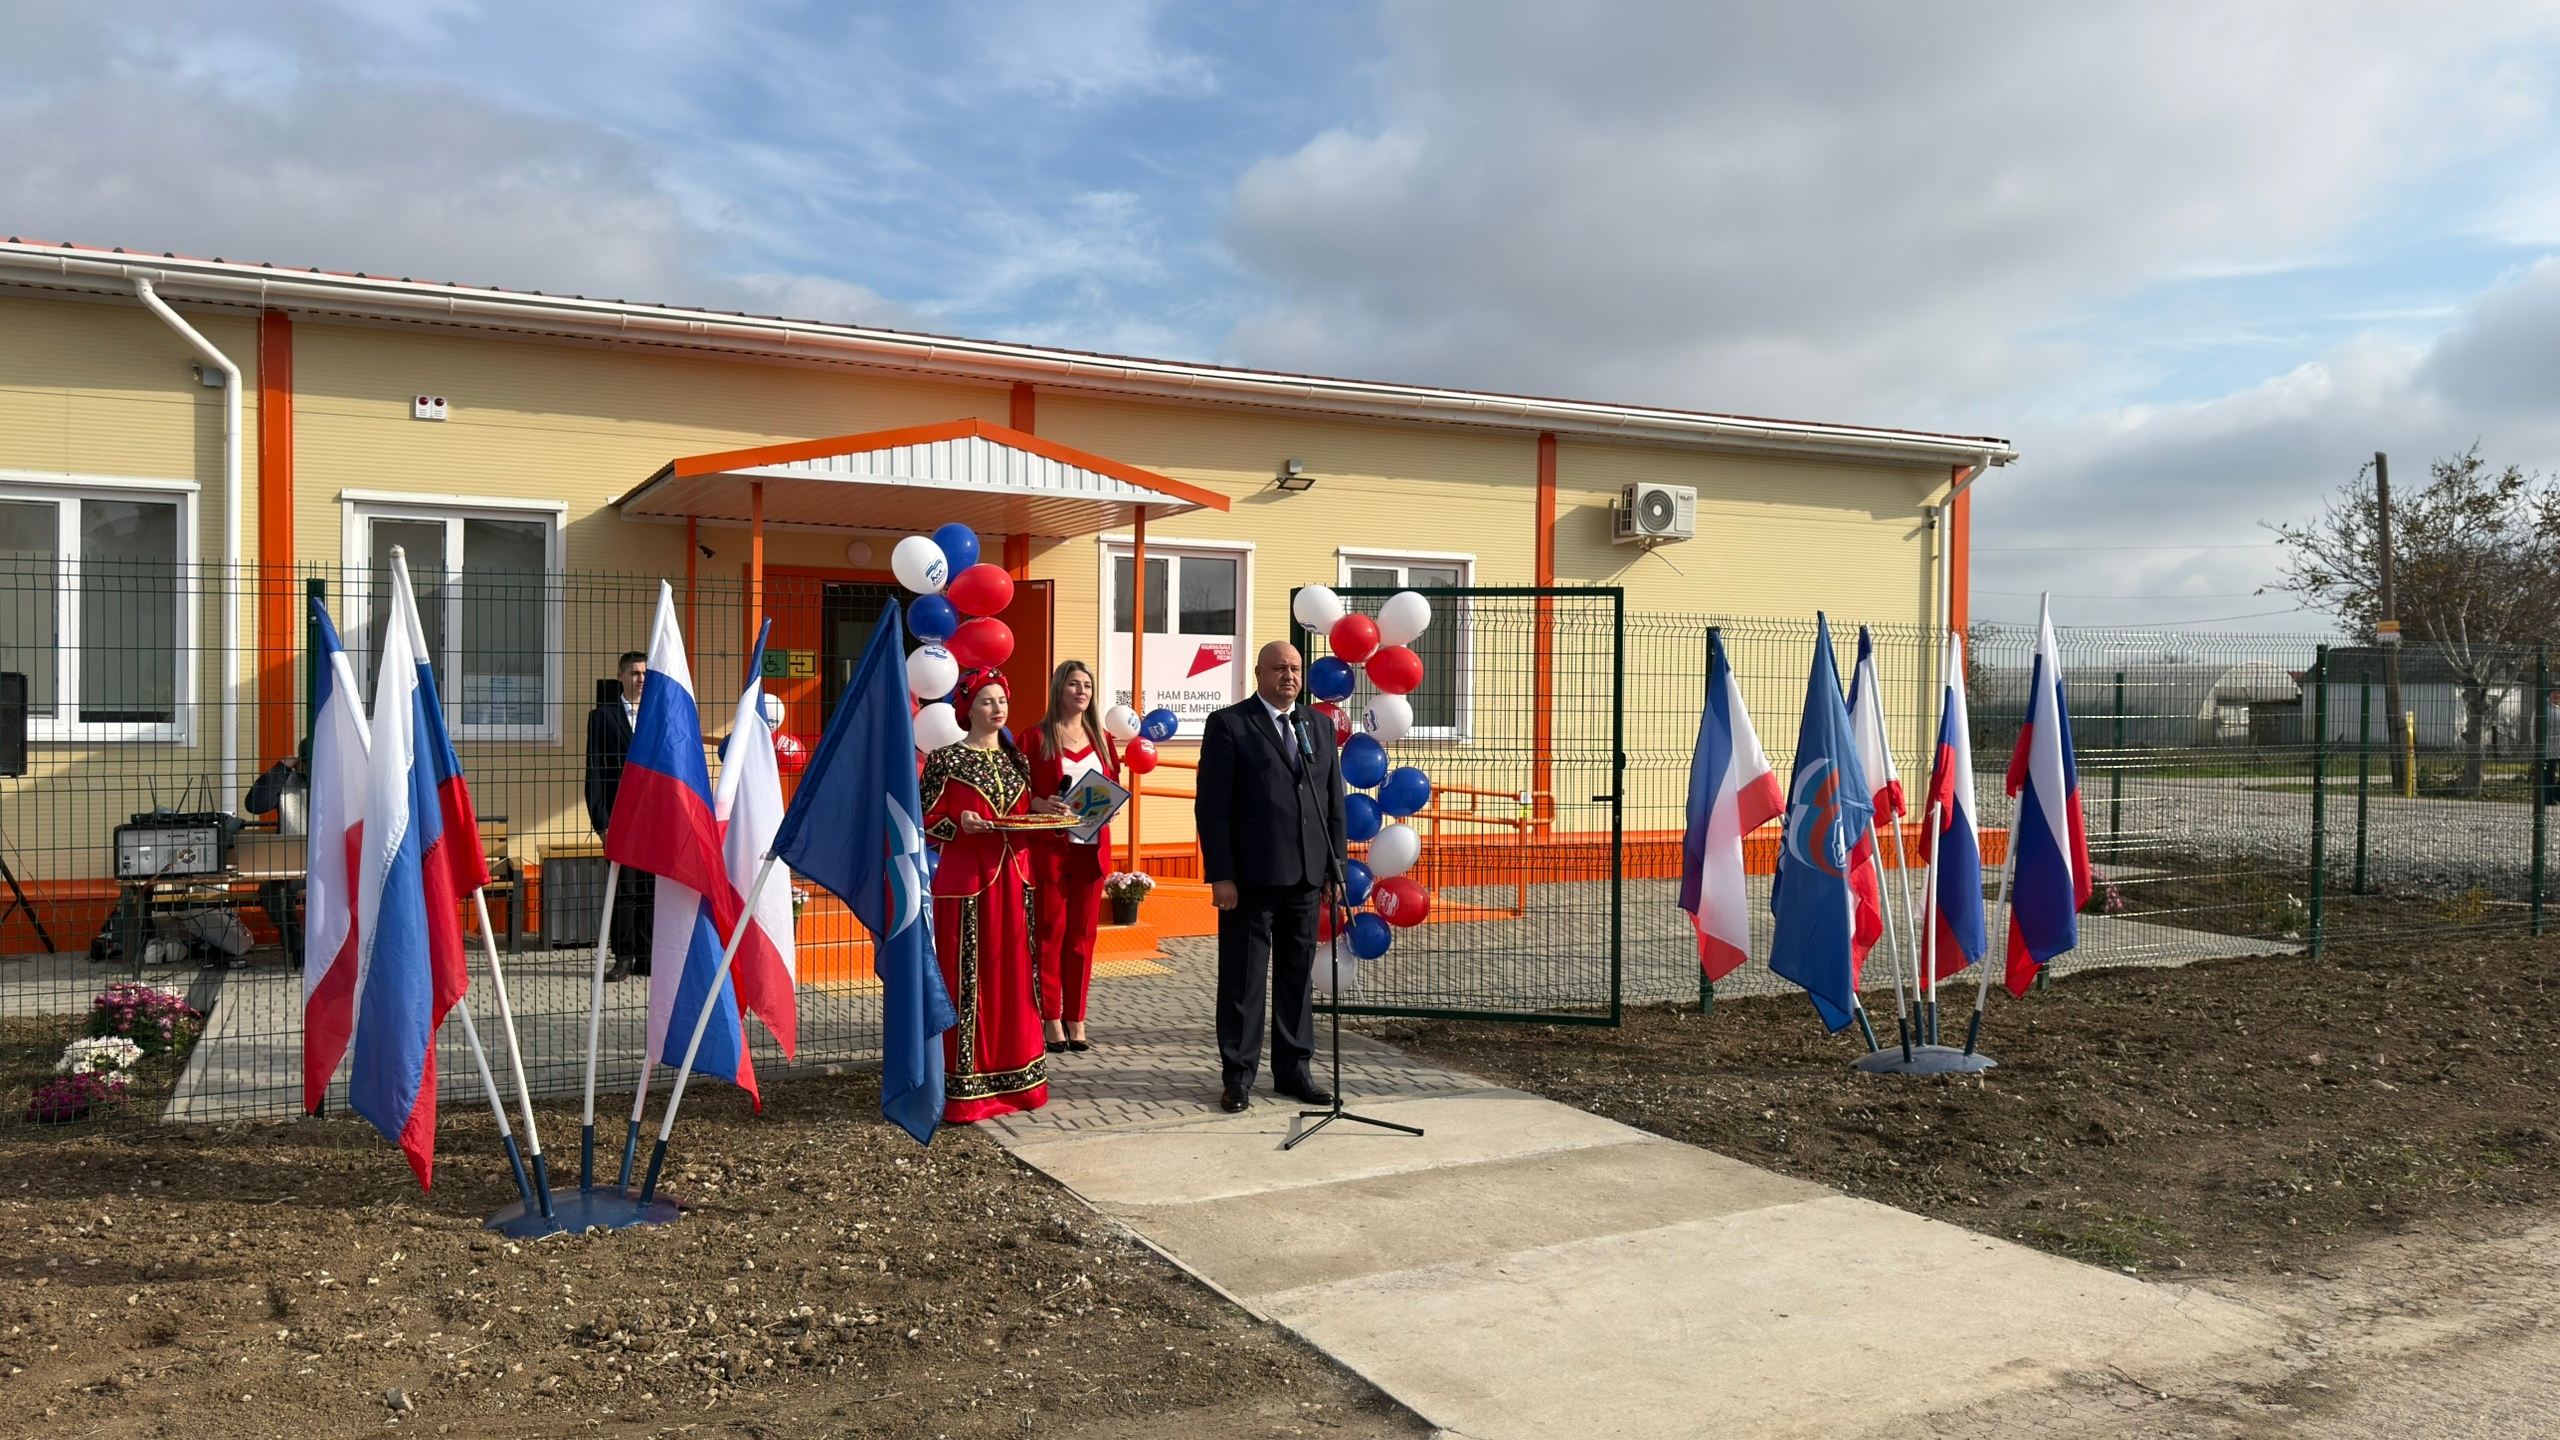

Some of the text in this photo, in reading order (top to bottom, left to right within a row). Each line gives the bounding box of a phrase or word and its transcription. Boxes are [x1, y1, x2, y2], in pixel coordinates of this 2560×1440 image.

[1157, 691, 1222, 701] НАМ ВАЖНО
[1189, 704, 1232, 714] МНЕНИ
